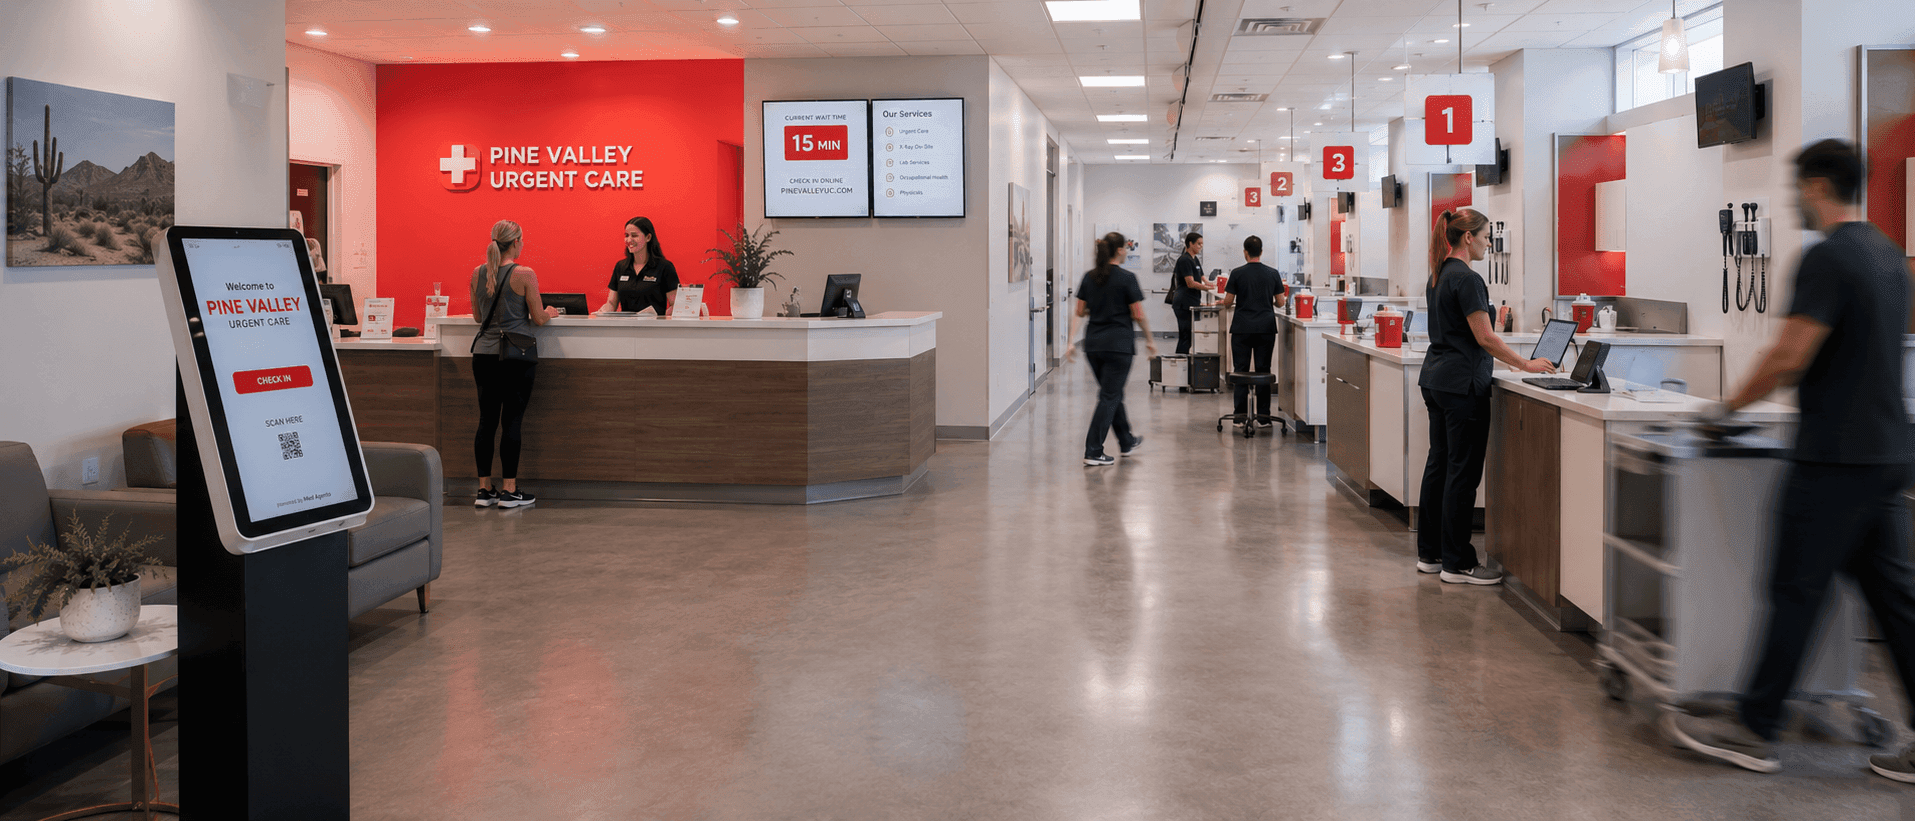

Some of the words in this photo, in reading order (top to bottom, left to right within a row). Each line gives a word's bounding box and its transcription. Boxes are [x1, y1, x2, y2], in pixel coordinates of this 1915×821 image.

[882, 110, 898, 118] Our
[899, 110, 933, 118] Services
[1441, 106, 1454, 134] 1
[792, 134, 814, 152] 15
[817, 140, 841, 151] MIN
[490, 146, 540, 164] PINE
[546, 145, 633, 163] VALLEY
[1331, 153, 1346, 172] 3
[490, 170, 578, 188] URGENT
[584, 170, 644, 187] CARE
[1276, 177, 1287, 191] 2
[1249, 191, 1258, 203] 3
[225, 282, 264, 291] Welcome
[265, 282, 275, 290] to
[206, 300, 244, 315] PINE
[246, 297, 301, 313] VALLEY
[228, 318, 265, 329] URGENT
[267, 317, 291, 326] CARE
[257, 376, 283, 385] CHECK
[282, 374, 292, 382] IN
[265, 419, 285, 428] SCAN
[285, 415, 303, 424] HERE
